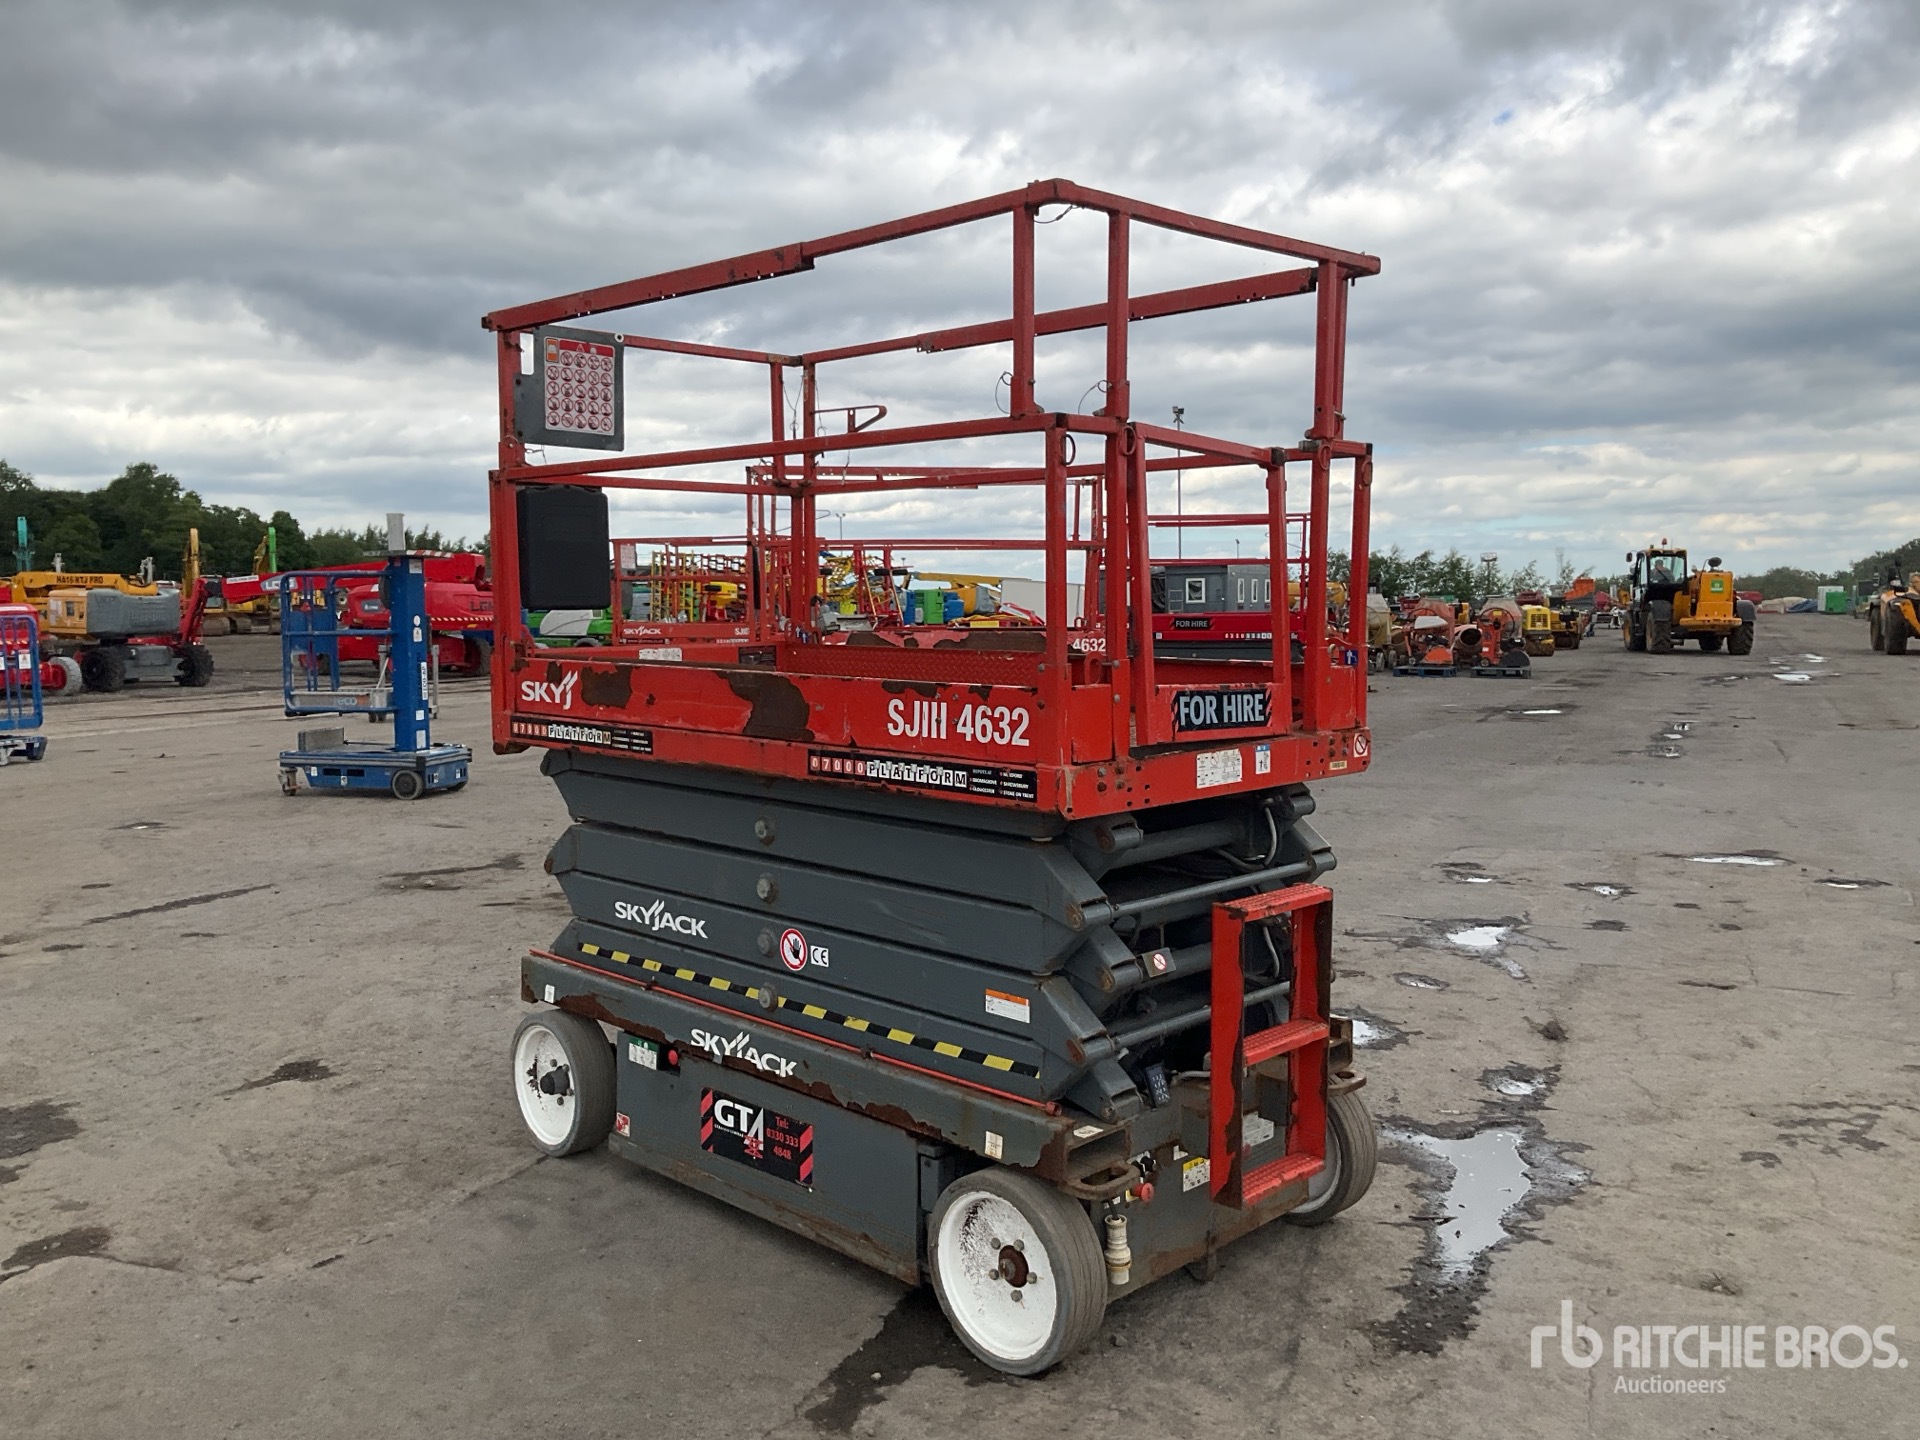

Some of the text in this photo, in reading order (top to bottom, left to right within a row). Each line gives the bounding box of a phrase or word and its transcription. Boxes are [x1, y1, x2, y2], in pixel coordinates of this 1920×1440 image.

[623, 625, 661, 636] SKYJACK
[1175, 620, 1208, 628] FOR HIRE
[1071, 638, 1106, 652] 4632
[1179, 693, 1265, 726] FOR HIRE
[956, 703, 1029, 747] 4632
[868, 761, 967, 786] PLATFORM
[614, 899, 708, 939] SKYJACK
[690, 1028, 797, 1078] SKYJACK
[766, 1127, 799, 1148] 0330 333
